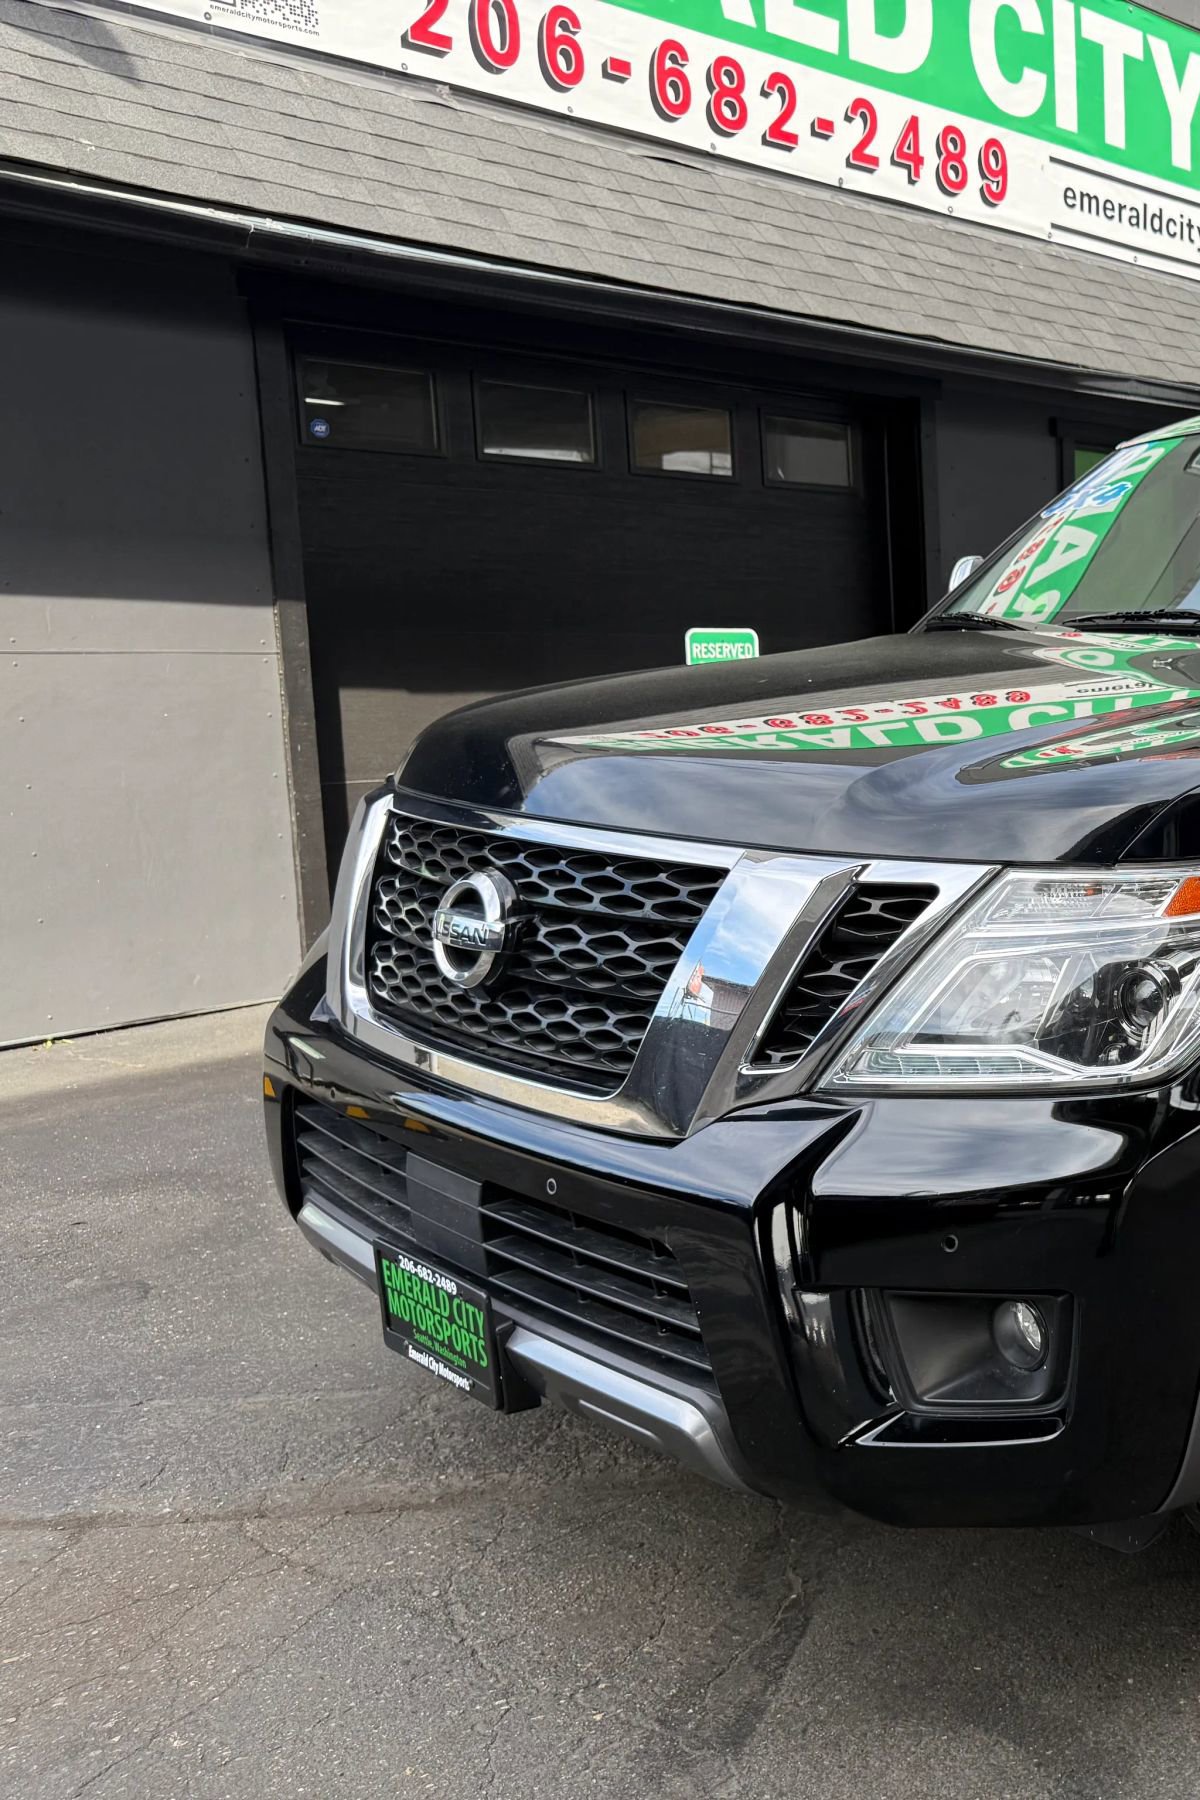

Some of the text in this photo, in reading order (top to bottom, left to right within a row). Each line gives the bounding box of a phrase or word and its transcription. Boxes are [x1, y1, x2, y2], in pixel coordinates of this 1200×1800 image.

[209, 2, 320, 37] emeraldcitymotorsports.com
[400, 0, 1008, 207] 206-682-2489
[693, 642, 753, 659] RESERVED
[398, 1254, 458, 1296] 206-682-2489
[382, 1258, 484, 1338] EMERALD CITY
[387, 1287, 488, 1368] MOTORSPORTS
[408, 1345, 471, 1391] Emerald City Motorsports
[434, 1341, 467, 1369] Washington
